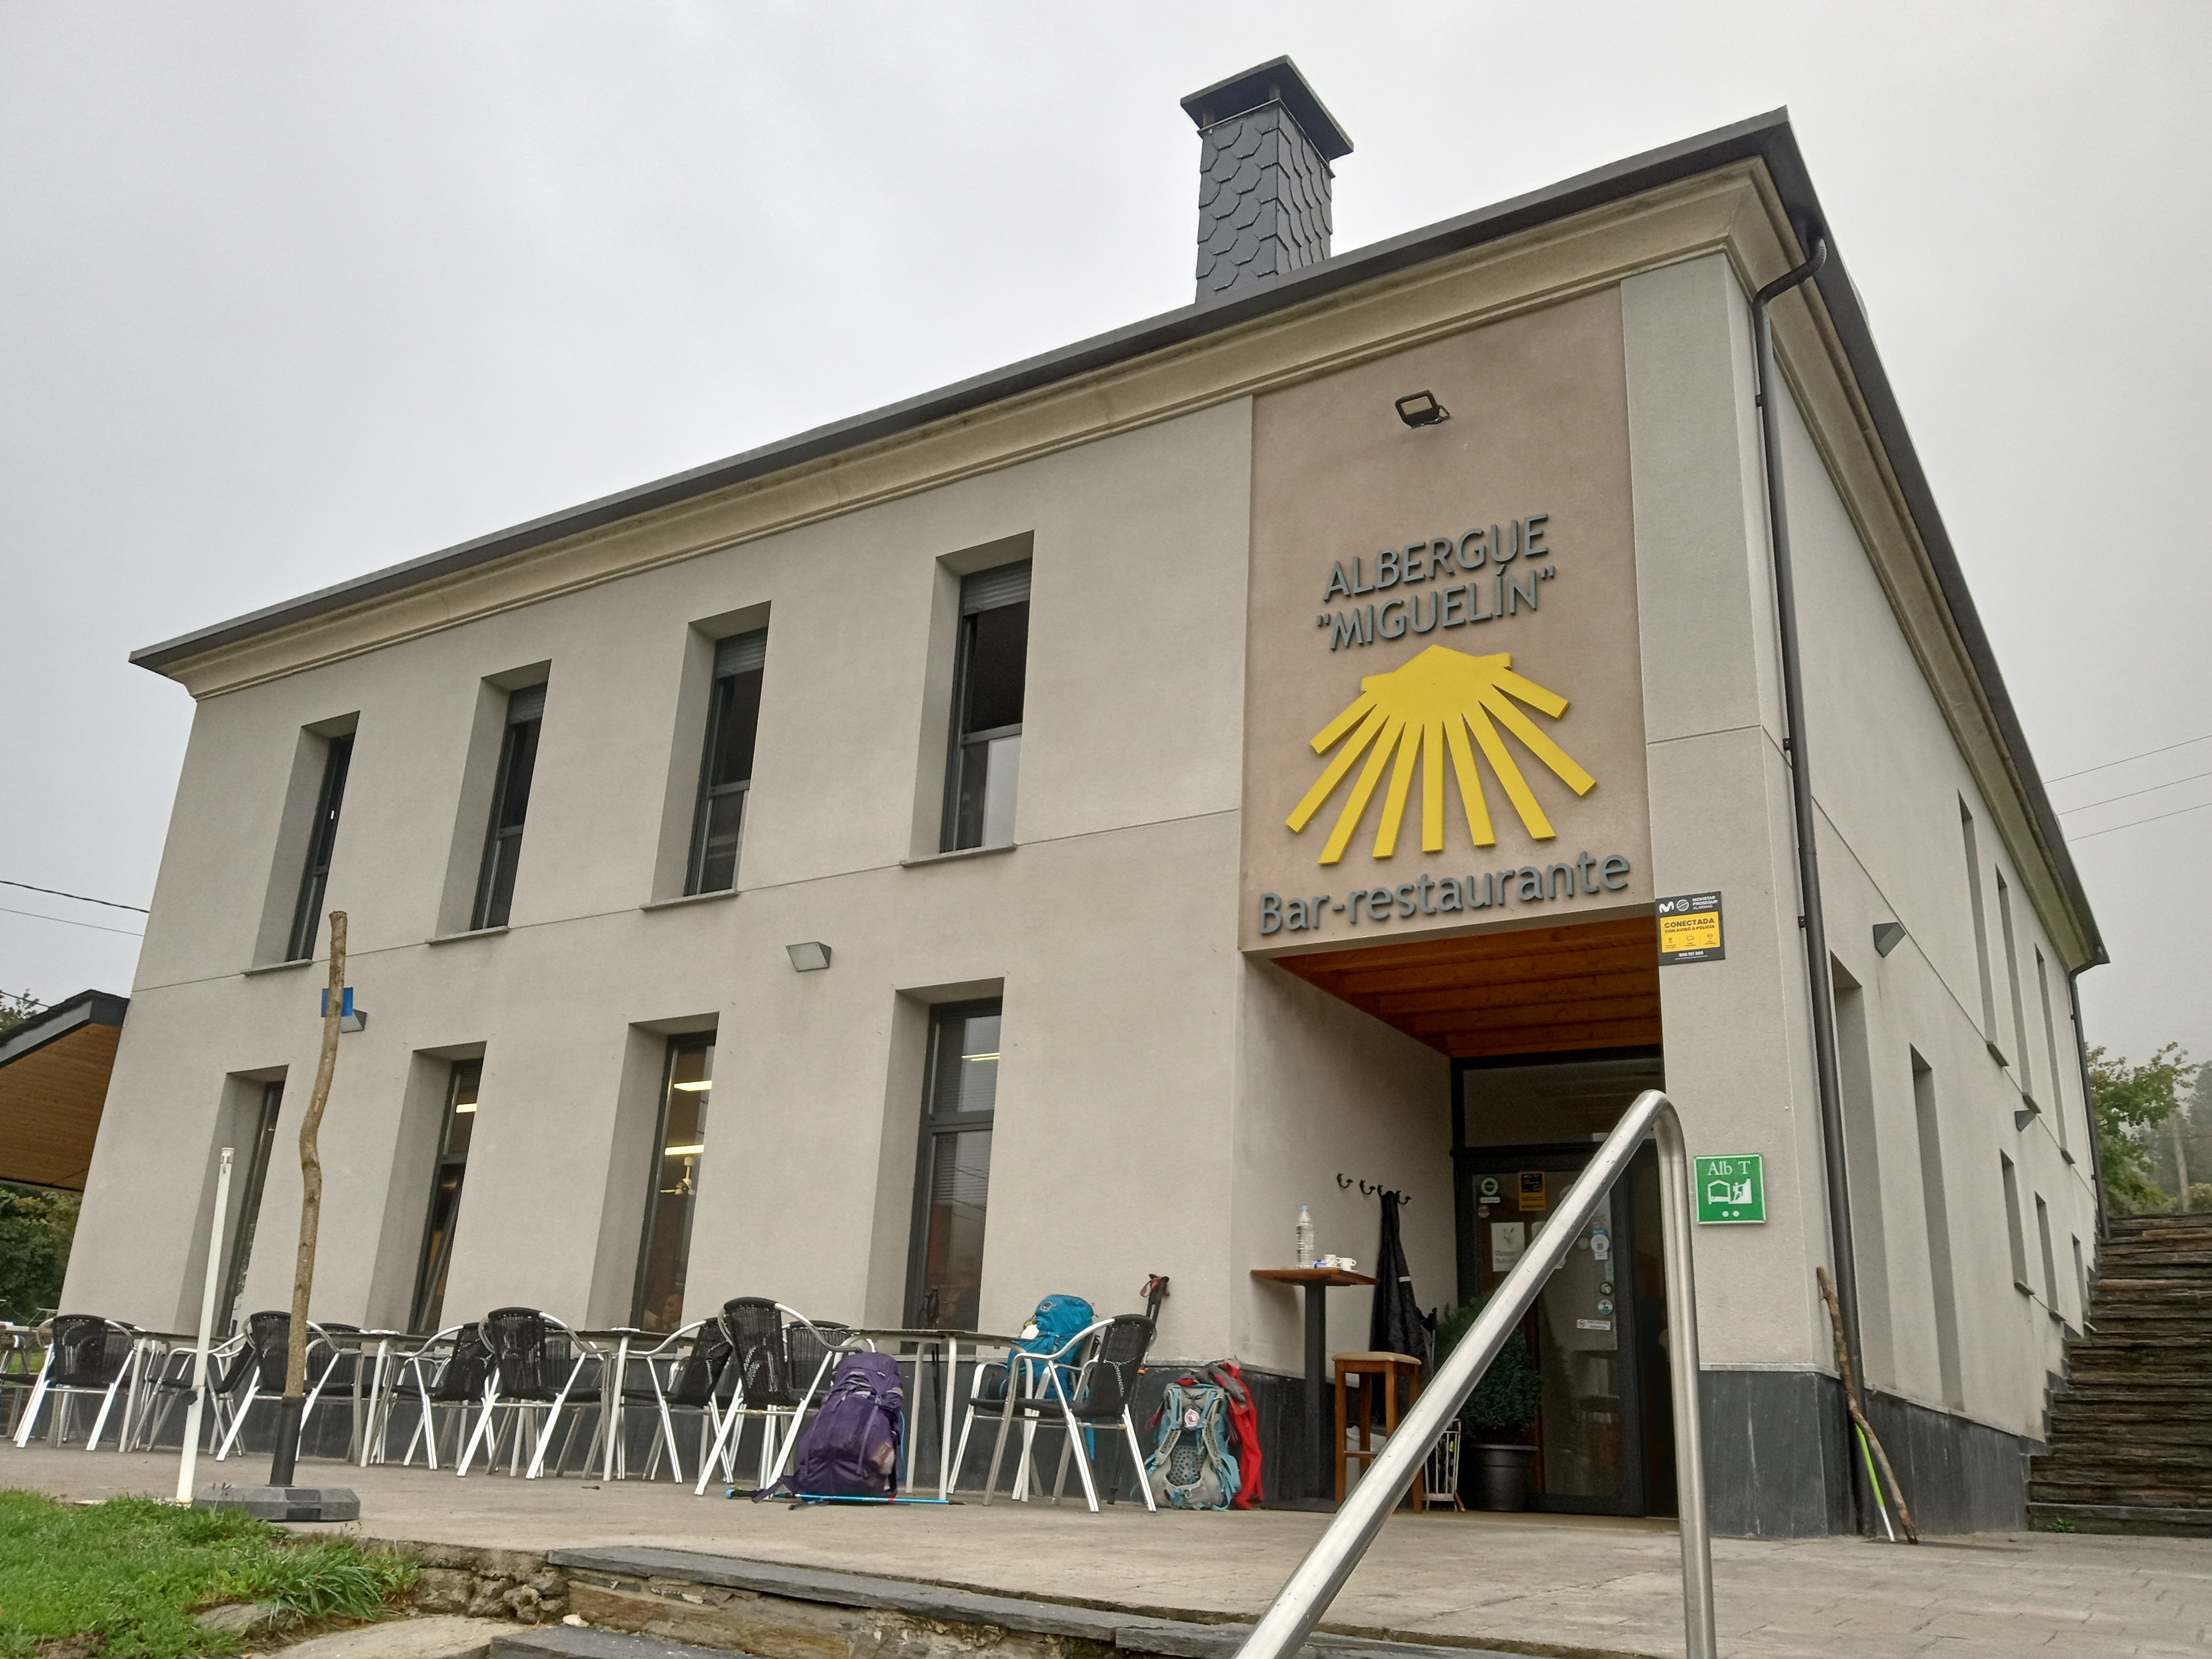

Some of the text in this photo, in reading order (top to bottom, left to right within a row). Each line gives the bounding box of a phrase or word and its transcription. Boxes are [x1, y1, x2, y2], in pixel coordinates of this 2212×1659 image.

[1323, 513, 1549, 602] ALBERGUE
[1259, 851, 1631, 936] Bar-restaurante
[1664, 918, 1715, 928] CONECTADA
[1707, 1161, 1750, 1175] Alb T
